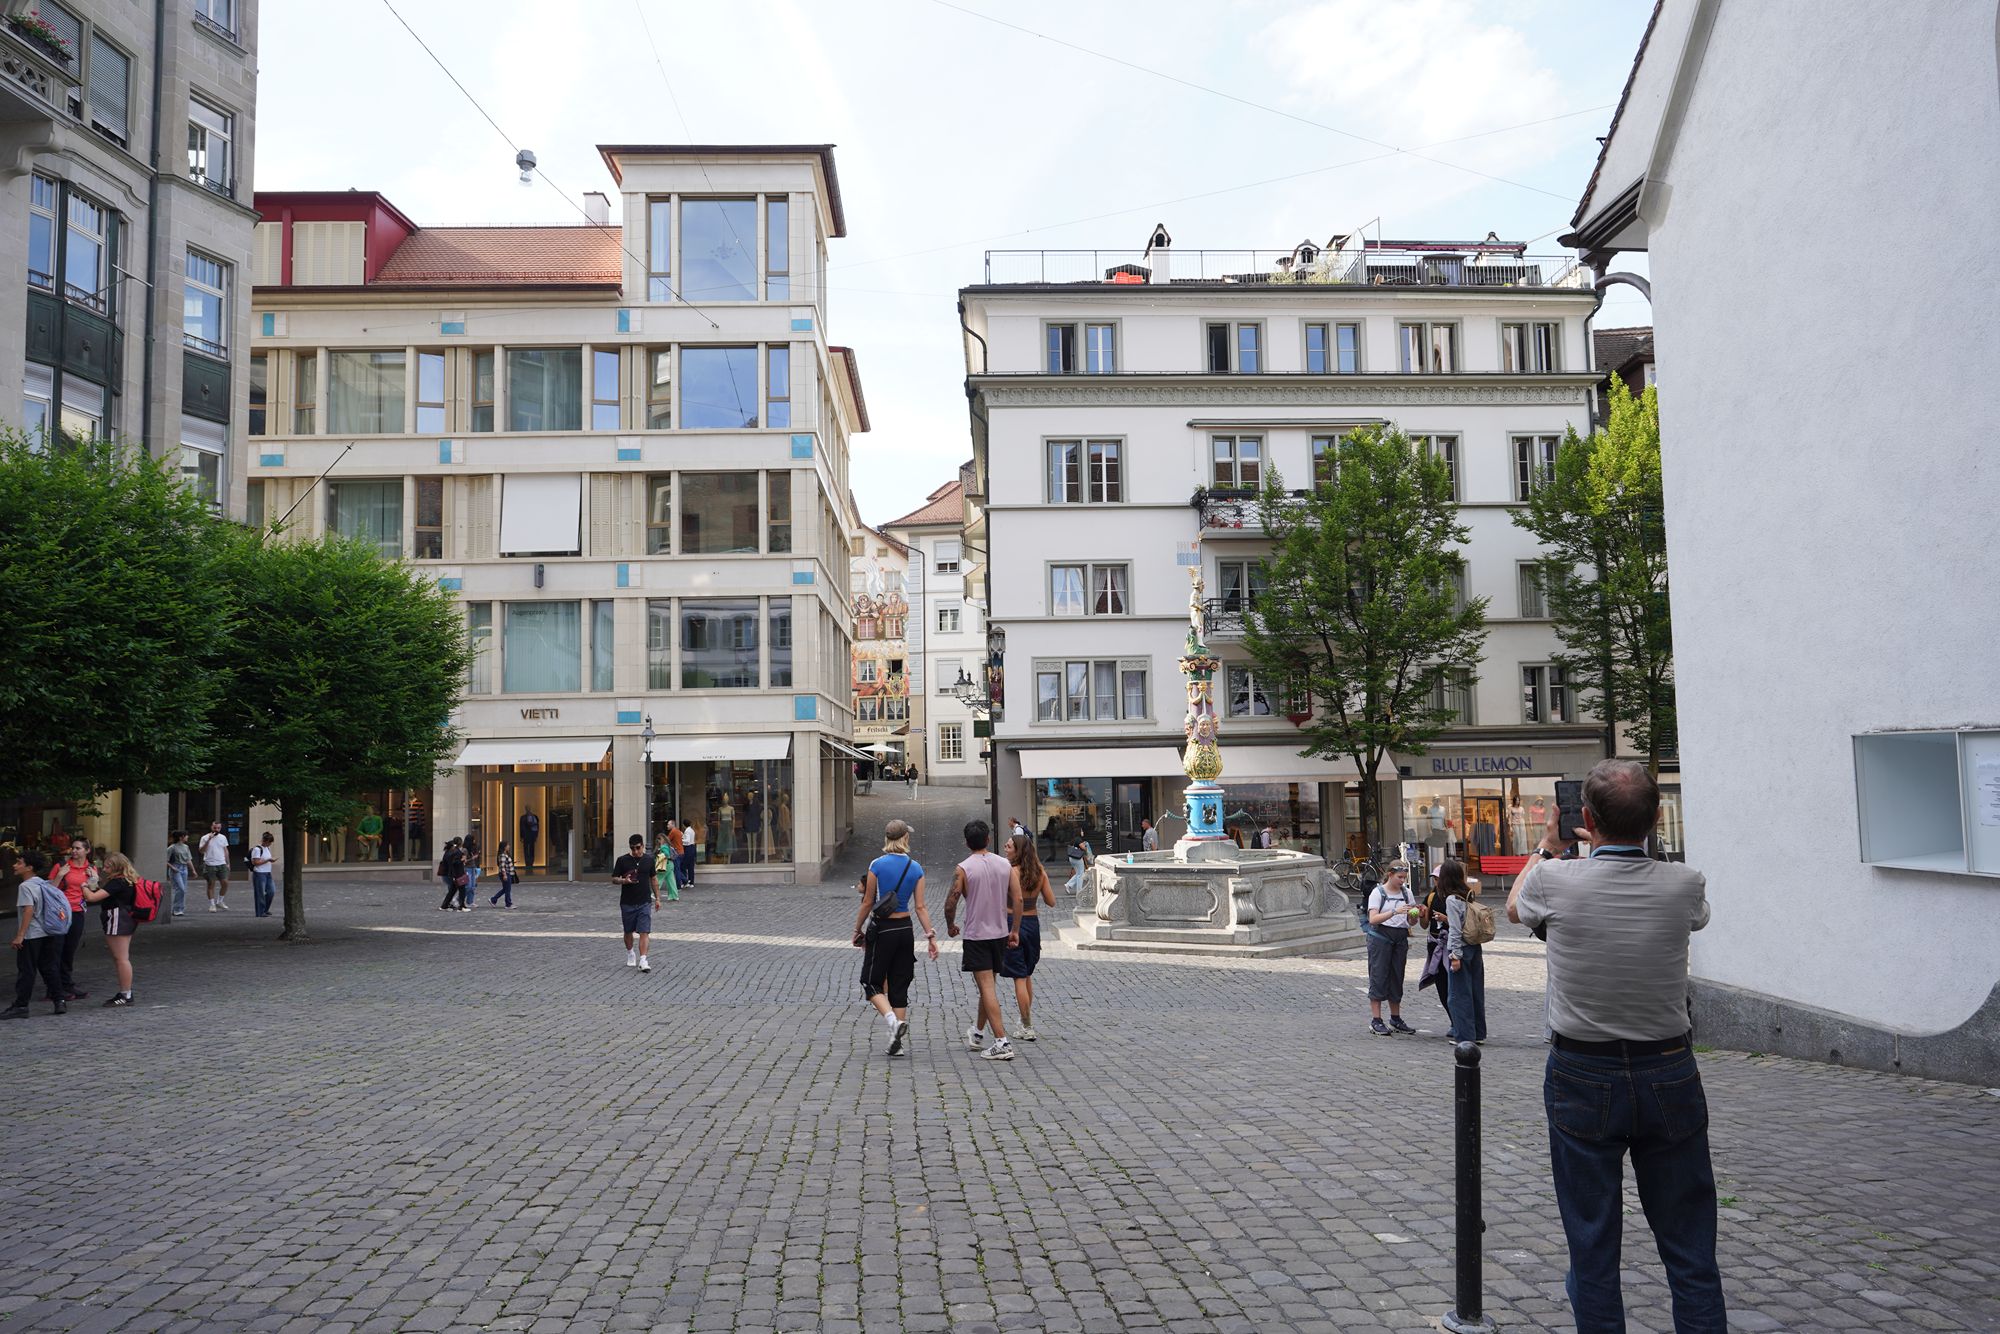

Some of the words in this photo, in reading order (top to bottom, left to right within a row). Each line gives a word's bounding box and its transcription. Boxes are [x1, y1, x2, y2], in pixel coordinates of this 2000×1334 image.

[520, 708, 560, 720] VIETTI
[1432, 757, 1469, 773] BLUE
[1474, 756, 1532, 772] LEMON
[1104, 803, 1112, 812] TO
[1105, 814, 1113, 830] TAKE
